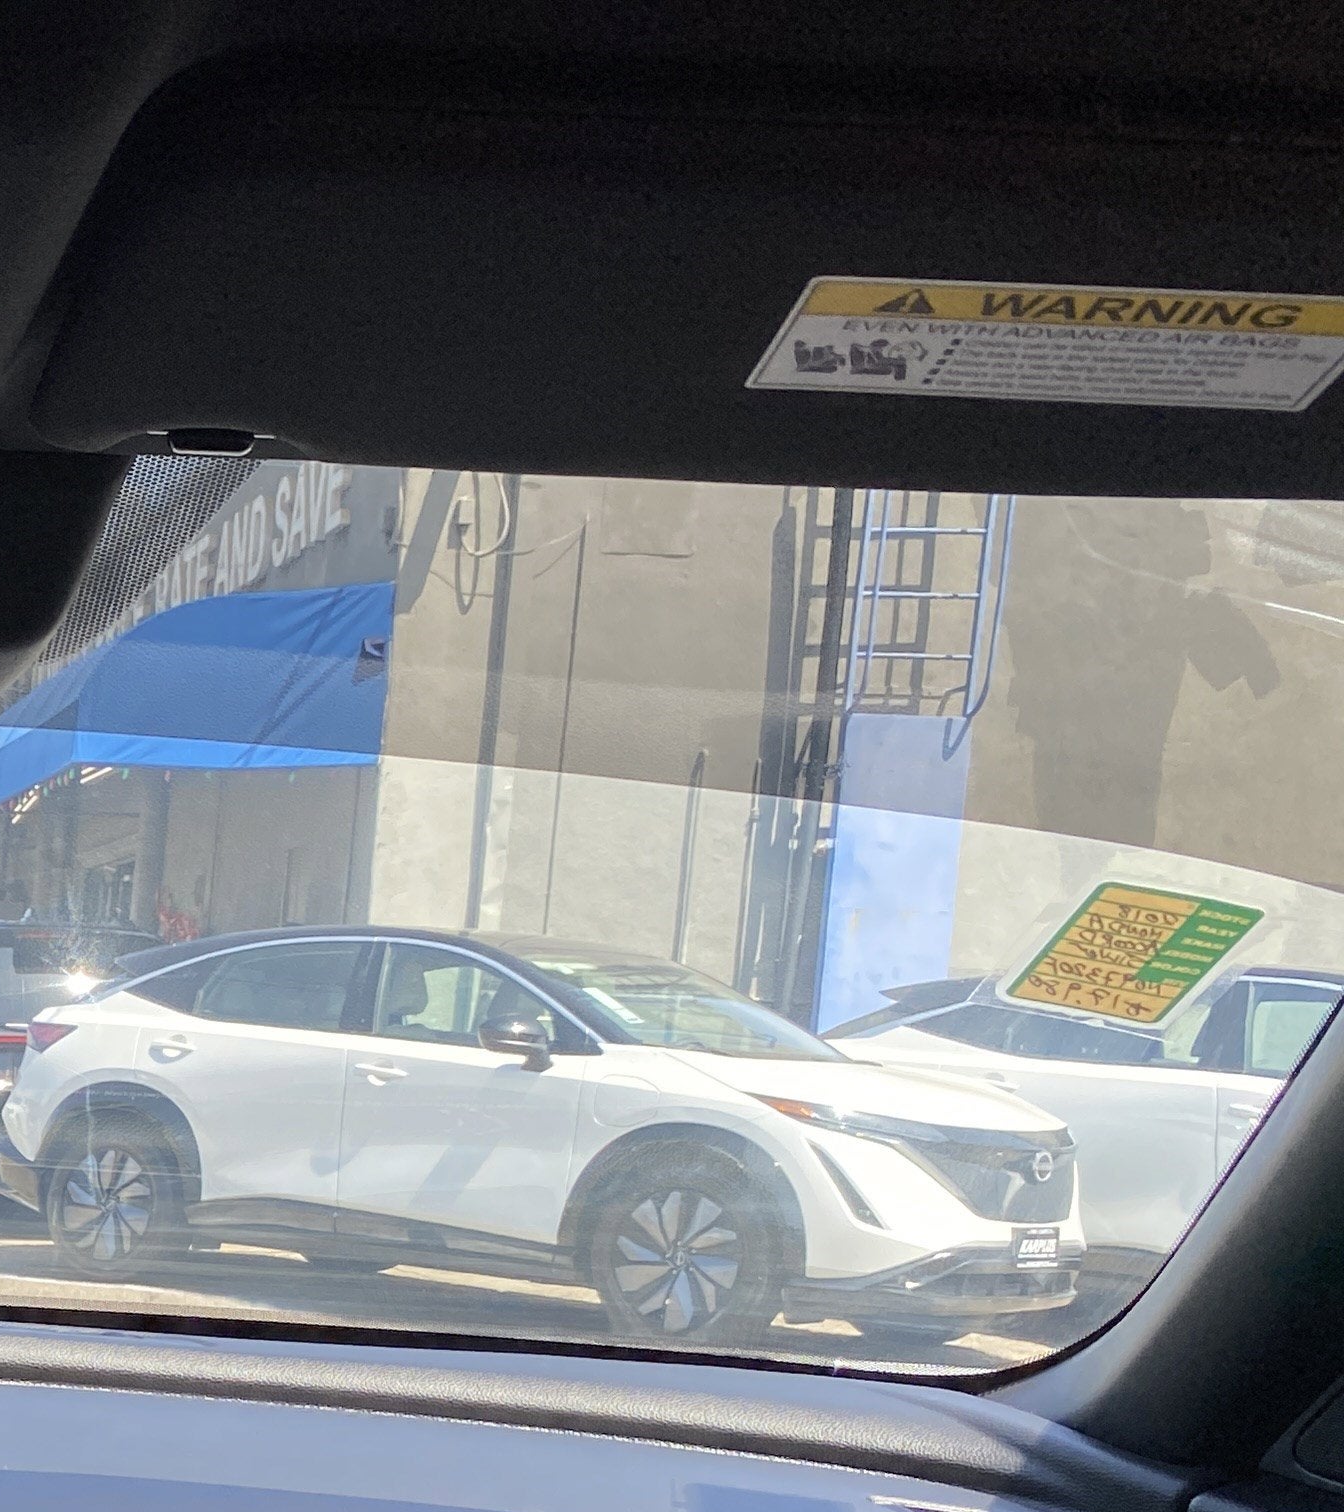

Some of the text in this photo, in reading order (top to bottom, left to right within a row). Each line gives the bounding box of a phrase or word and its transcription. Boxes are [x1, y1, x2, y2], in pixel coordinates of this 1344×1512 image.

[981, 293, 1302, 328] WARNING
[842, 320, 1301, 348] EVEN WITH ADVANCED AIR BAGS
[214, 494, 268, 598] AND
[272, 461, 352, 569] SAVE
